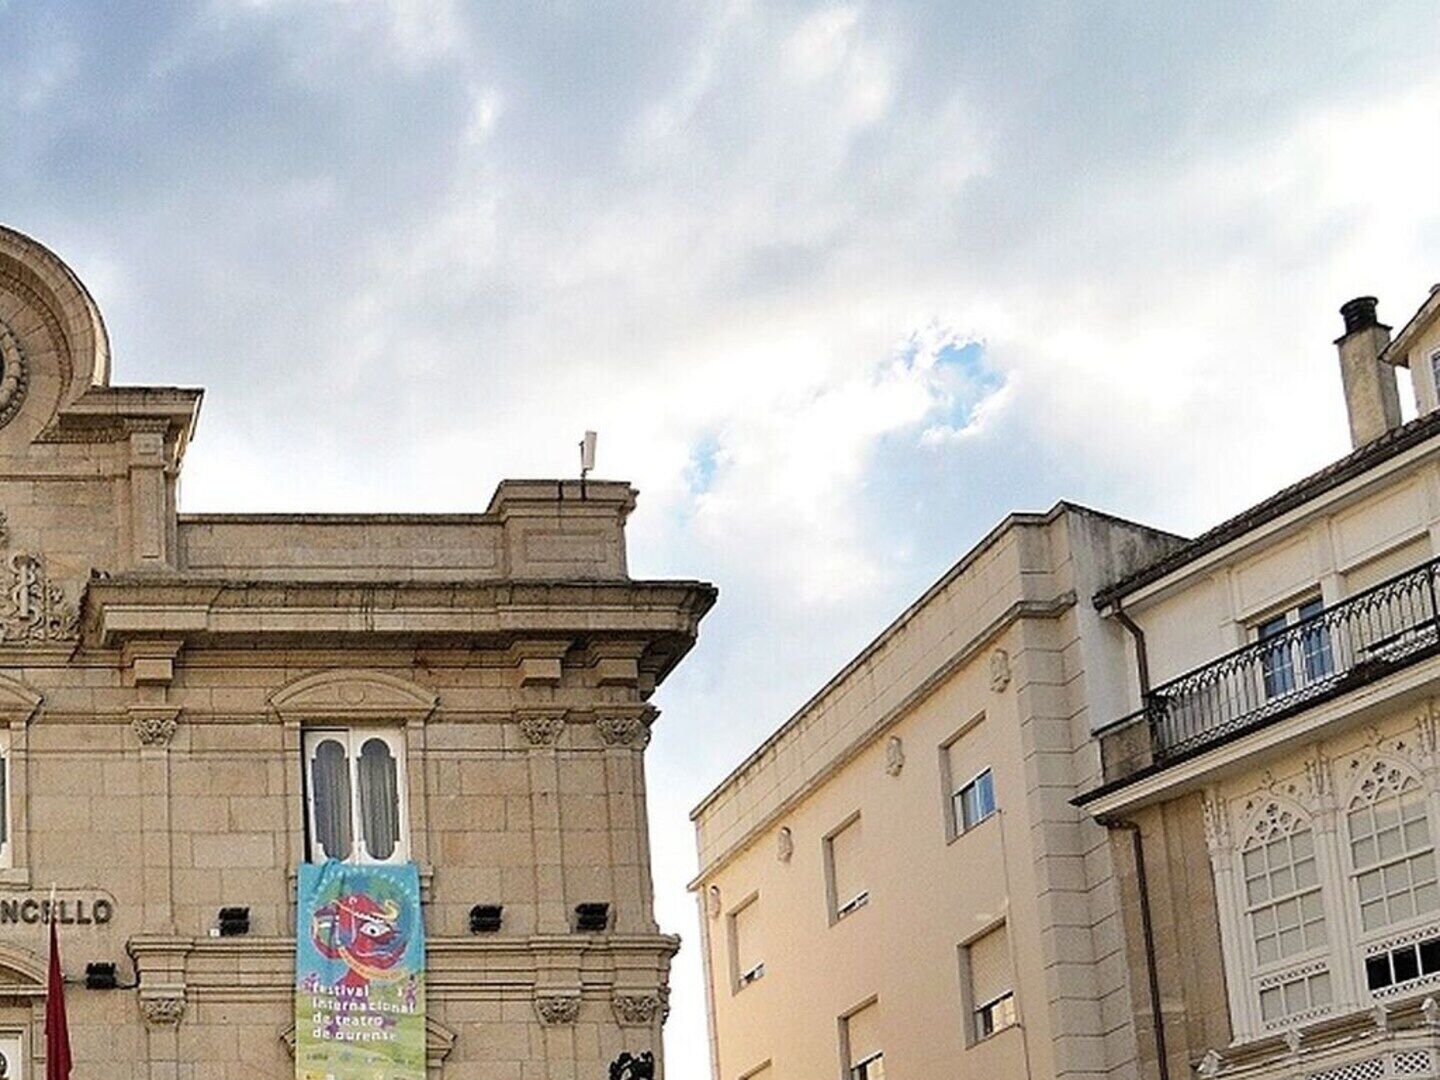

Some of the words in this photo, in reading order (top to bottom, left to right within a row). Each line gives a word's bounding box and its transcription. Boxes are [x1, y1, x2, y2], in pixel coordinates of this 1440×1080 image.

[313, 997, 416, 1013] internacional
[312, 1011, 331, 1024] de
[336, 1015, 384, 1026] teatro
[312, 1026, 331, 1040] de
